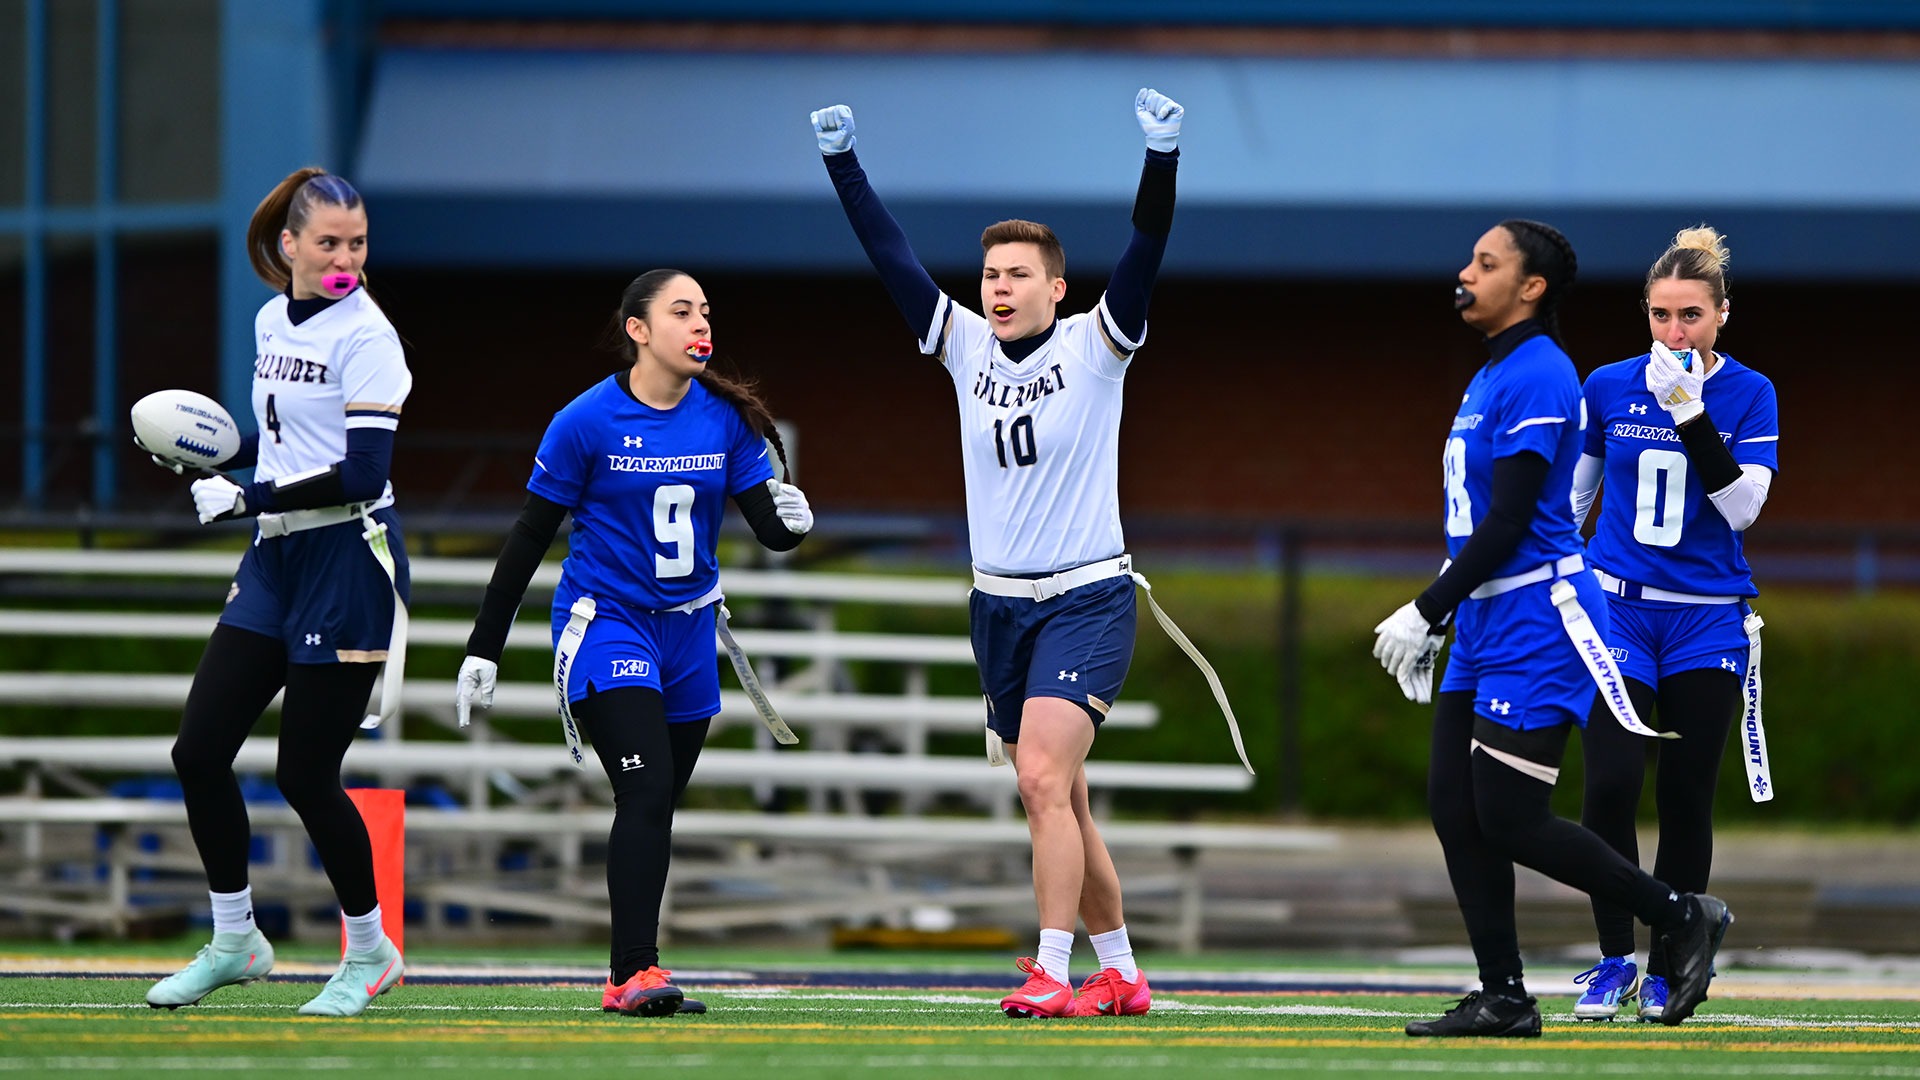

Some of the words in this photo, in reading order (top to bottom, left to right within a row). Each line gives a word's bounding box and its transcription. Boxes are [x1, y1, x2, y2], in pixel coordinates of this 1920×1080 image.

[256, 354, 327, 384] LLAUDET
[266, 393, 281, 444] 4
[994, 414, 1037, 469] 10
[1613, 424, 1732, 443] MARYMT
[607, 453, 725, 473] MARYMOUNT
[1633, 448, 1687, 547] 0
[653, 484, 695, 578] 9
[1582, 638, 1642, 731] MARYMOUN
[1746, 665, 1763, 767] MARYMOUNT
